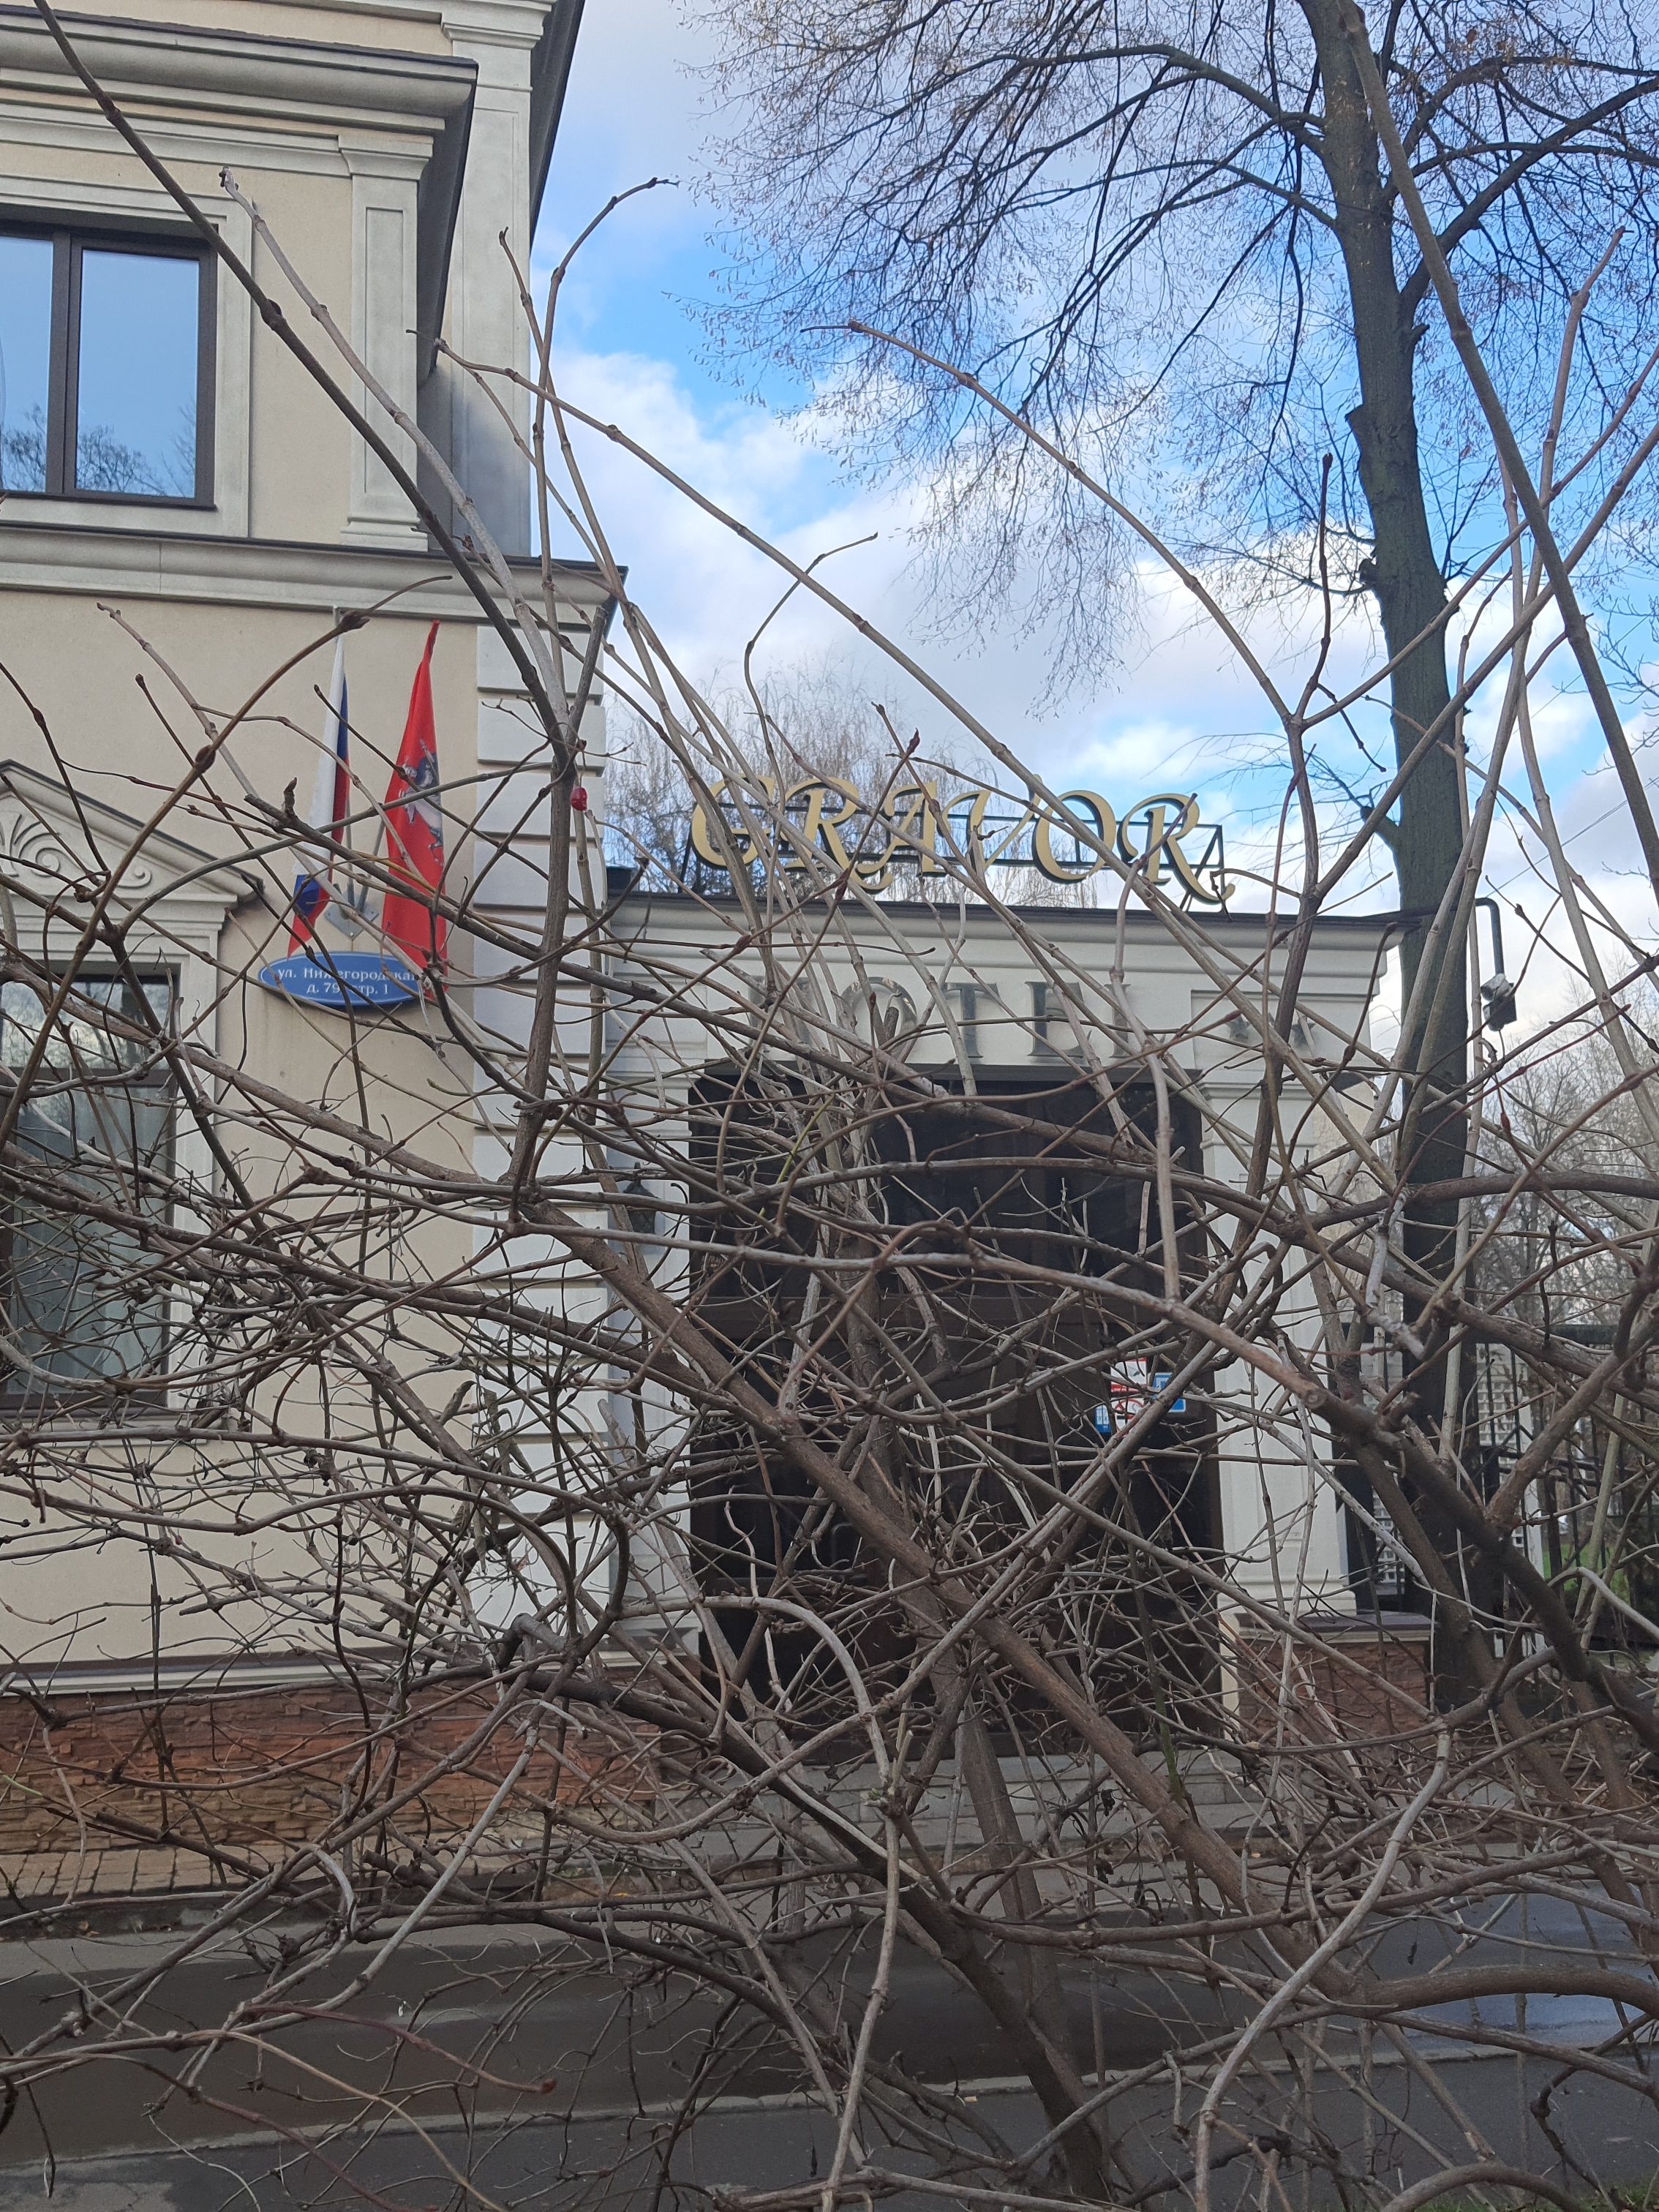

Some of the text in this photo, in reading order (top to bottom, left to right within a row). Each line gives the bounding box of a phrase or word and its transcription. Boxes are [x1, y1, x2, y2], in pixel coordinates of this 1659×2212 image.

[692, 773, 1235, 903] GRAVOR
[278, 968, 416, 982] ул. Ниегородка
[306, 984, 319, 994] д.
[348, 984, 378, 997] тр.
